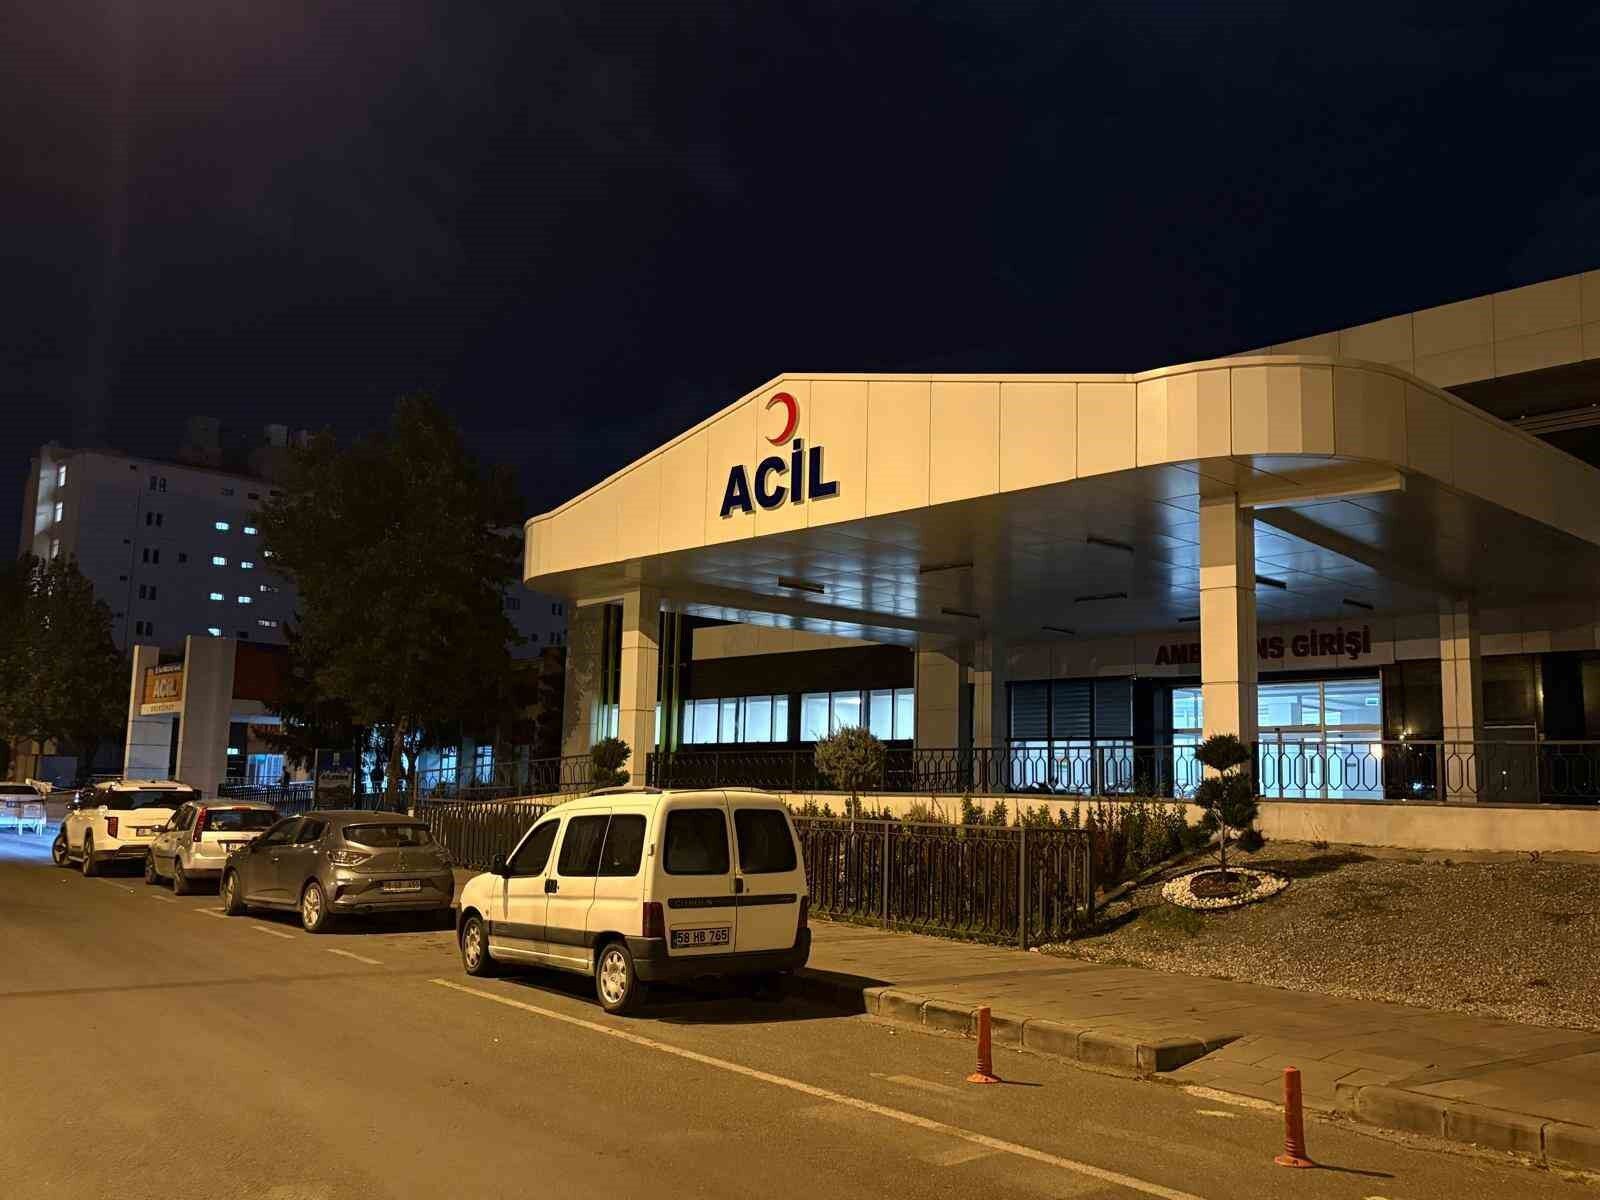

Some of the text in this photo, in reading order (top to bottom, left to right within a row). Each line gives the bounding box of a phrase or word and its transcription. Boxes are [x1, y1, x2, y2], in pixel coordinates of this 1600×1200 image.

[720, 438, 838, 517] ACİL
[1155, 625, 1371, 665] AMBNS GİRİŞİ
